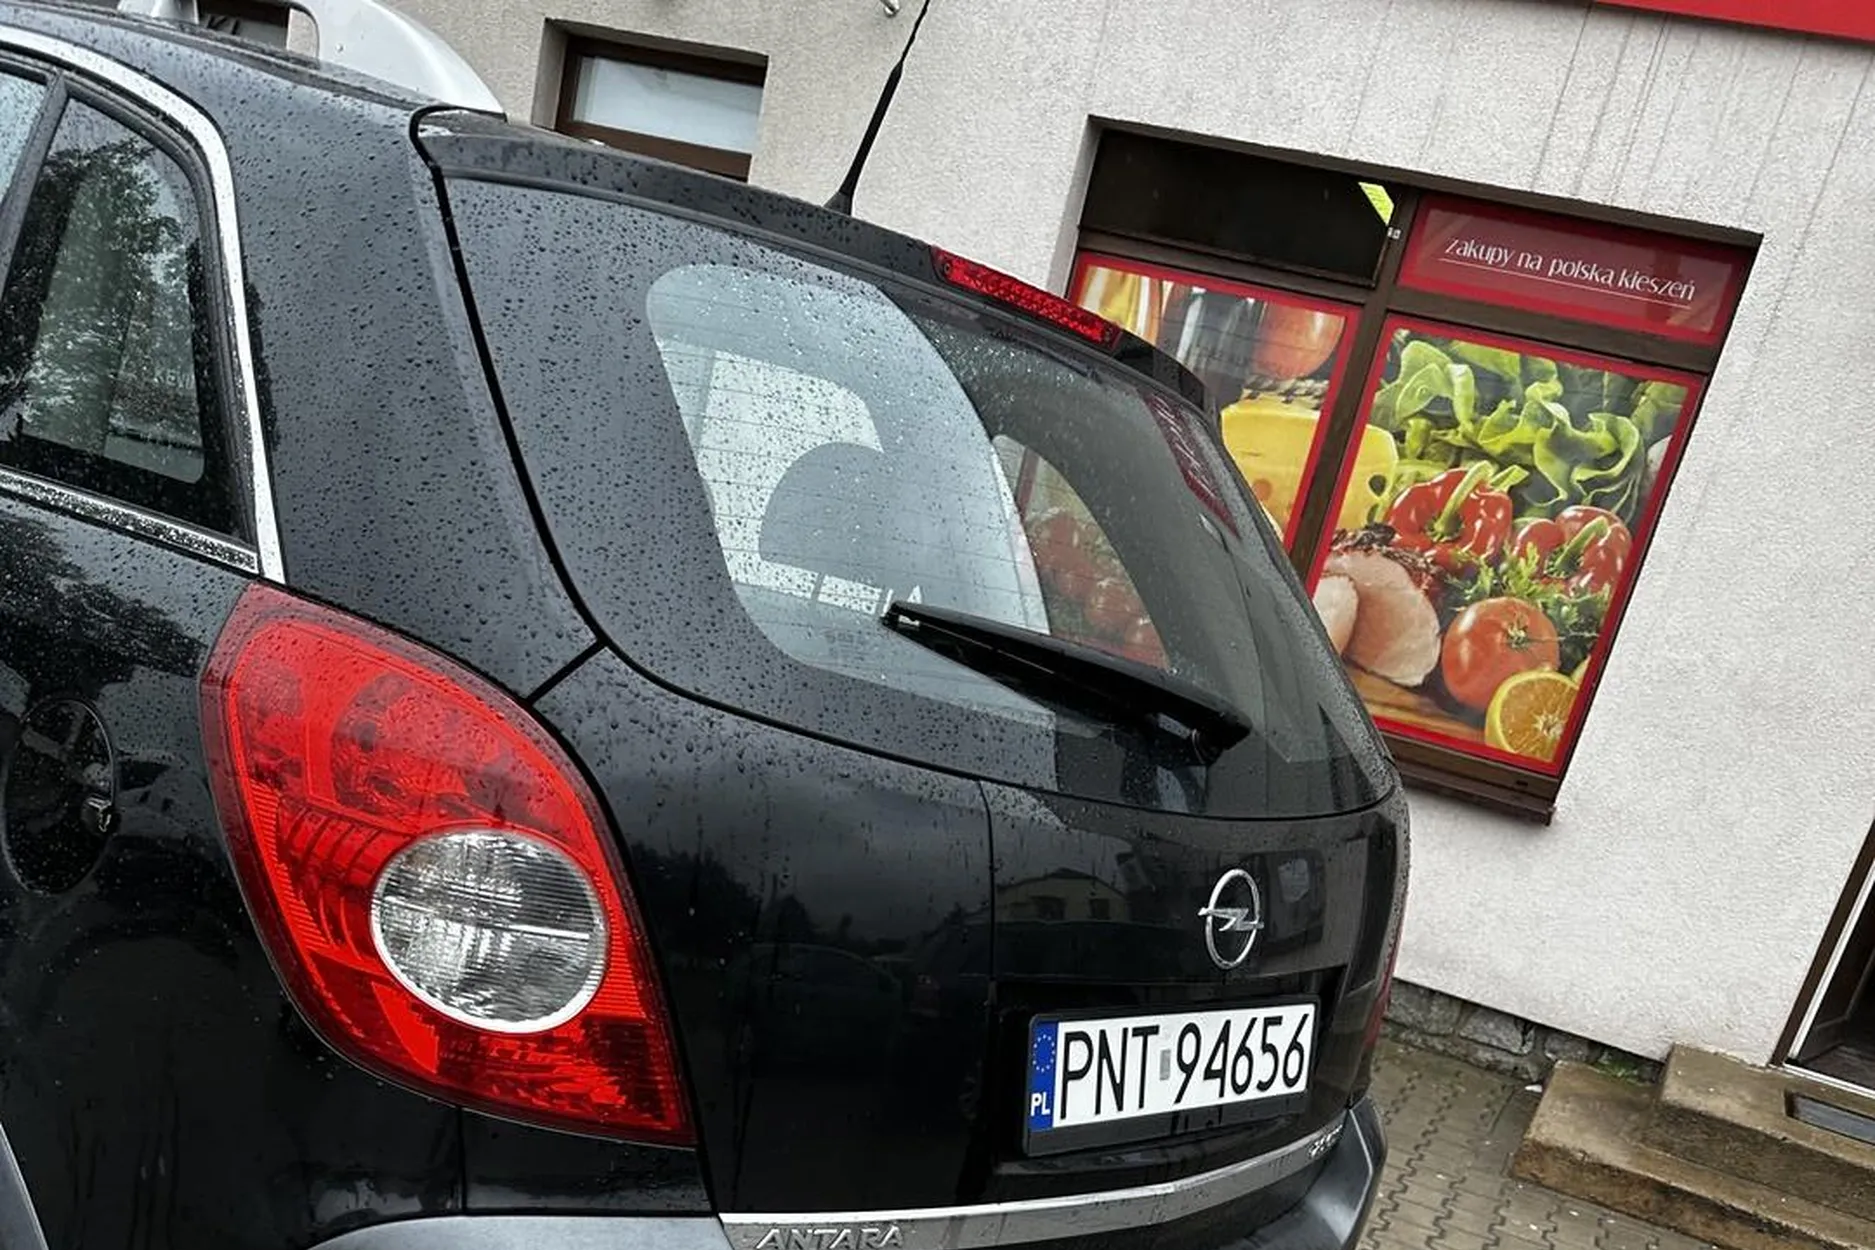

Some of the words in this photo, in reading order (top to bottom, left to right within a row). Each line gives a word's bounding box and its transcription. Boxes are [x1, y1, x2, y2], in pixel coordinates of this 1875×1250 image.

[1517, 250, 1543, 271] na
[1618, 268, 1695, 301] kieszeń
[1060, 1025, 1160, 1120] PNT
[1174, 1013, 1309, 1105] 94656
[1030, 1092, 1050, 1117] PL
[756, 1225, 905, 1250] ANTARA
